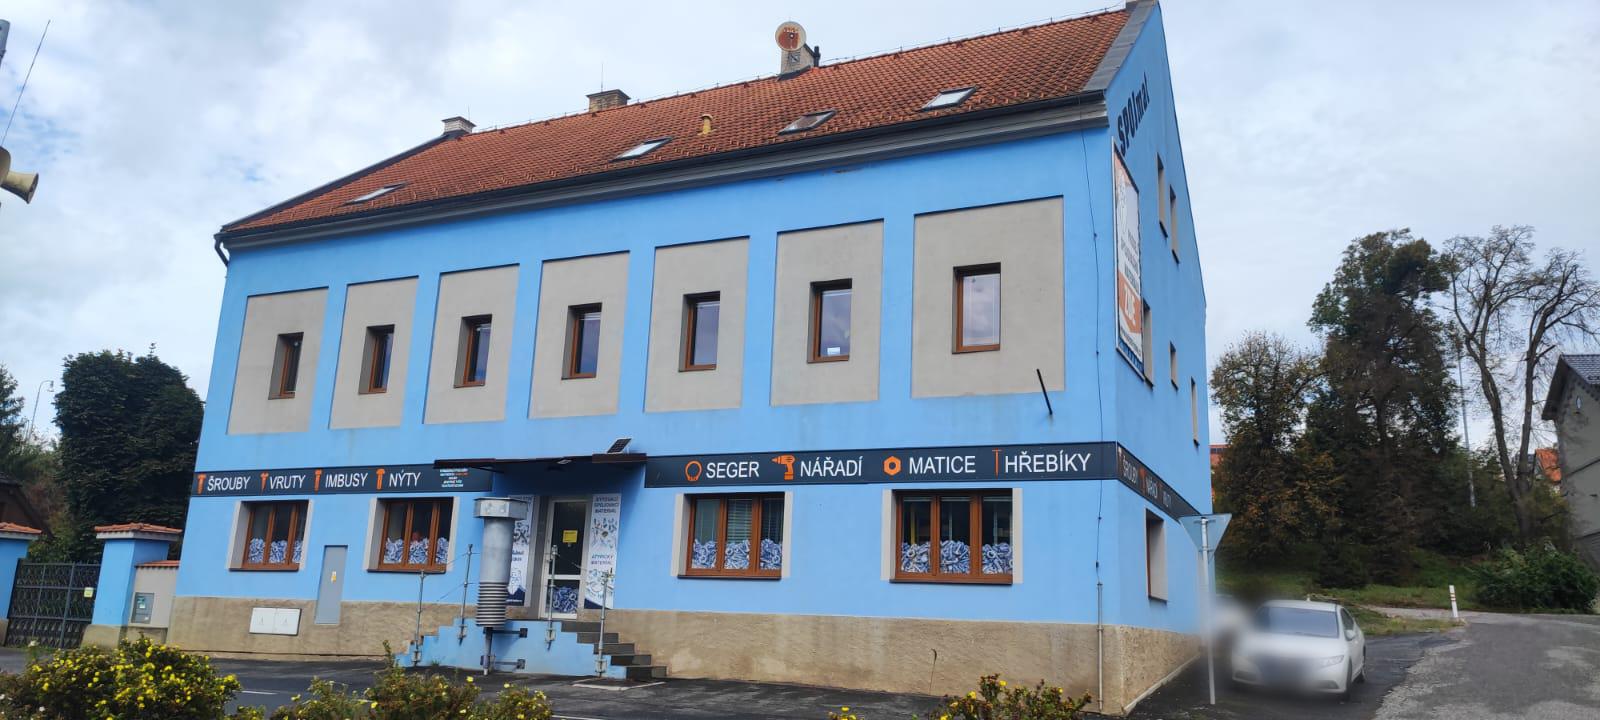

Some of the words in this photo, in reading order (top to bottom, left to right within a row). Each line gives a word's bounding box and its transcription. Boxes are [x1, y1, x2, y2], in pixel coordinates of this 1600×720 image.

[706, 460, 760, 480] SEGER
[800, 455, 864, 478] NÁŘADÍ
[908, 455, 976, 475] MATICE
[1004, 450, 1091, 475] HŘEBÍKY
[207, 474, 251, 492] ŠROUBY
[269, 474, 306, 490] VRUTY
[325, 472, 368, 488] IMBUSY
[389, 469, 421, 487] NÝTY
